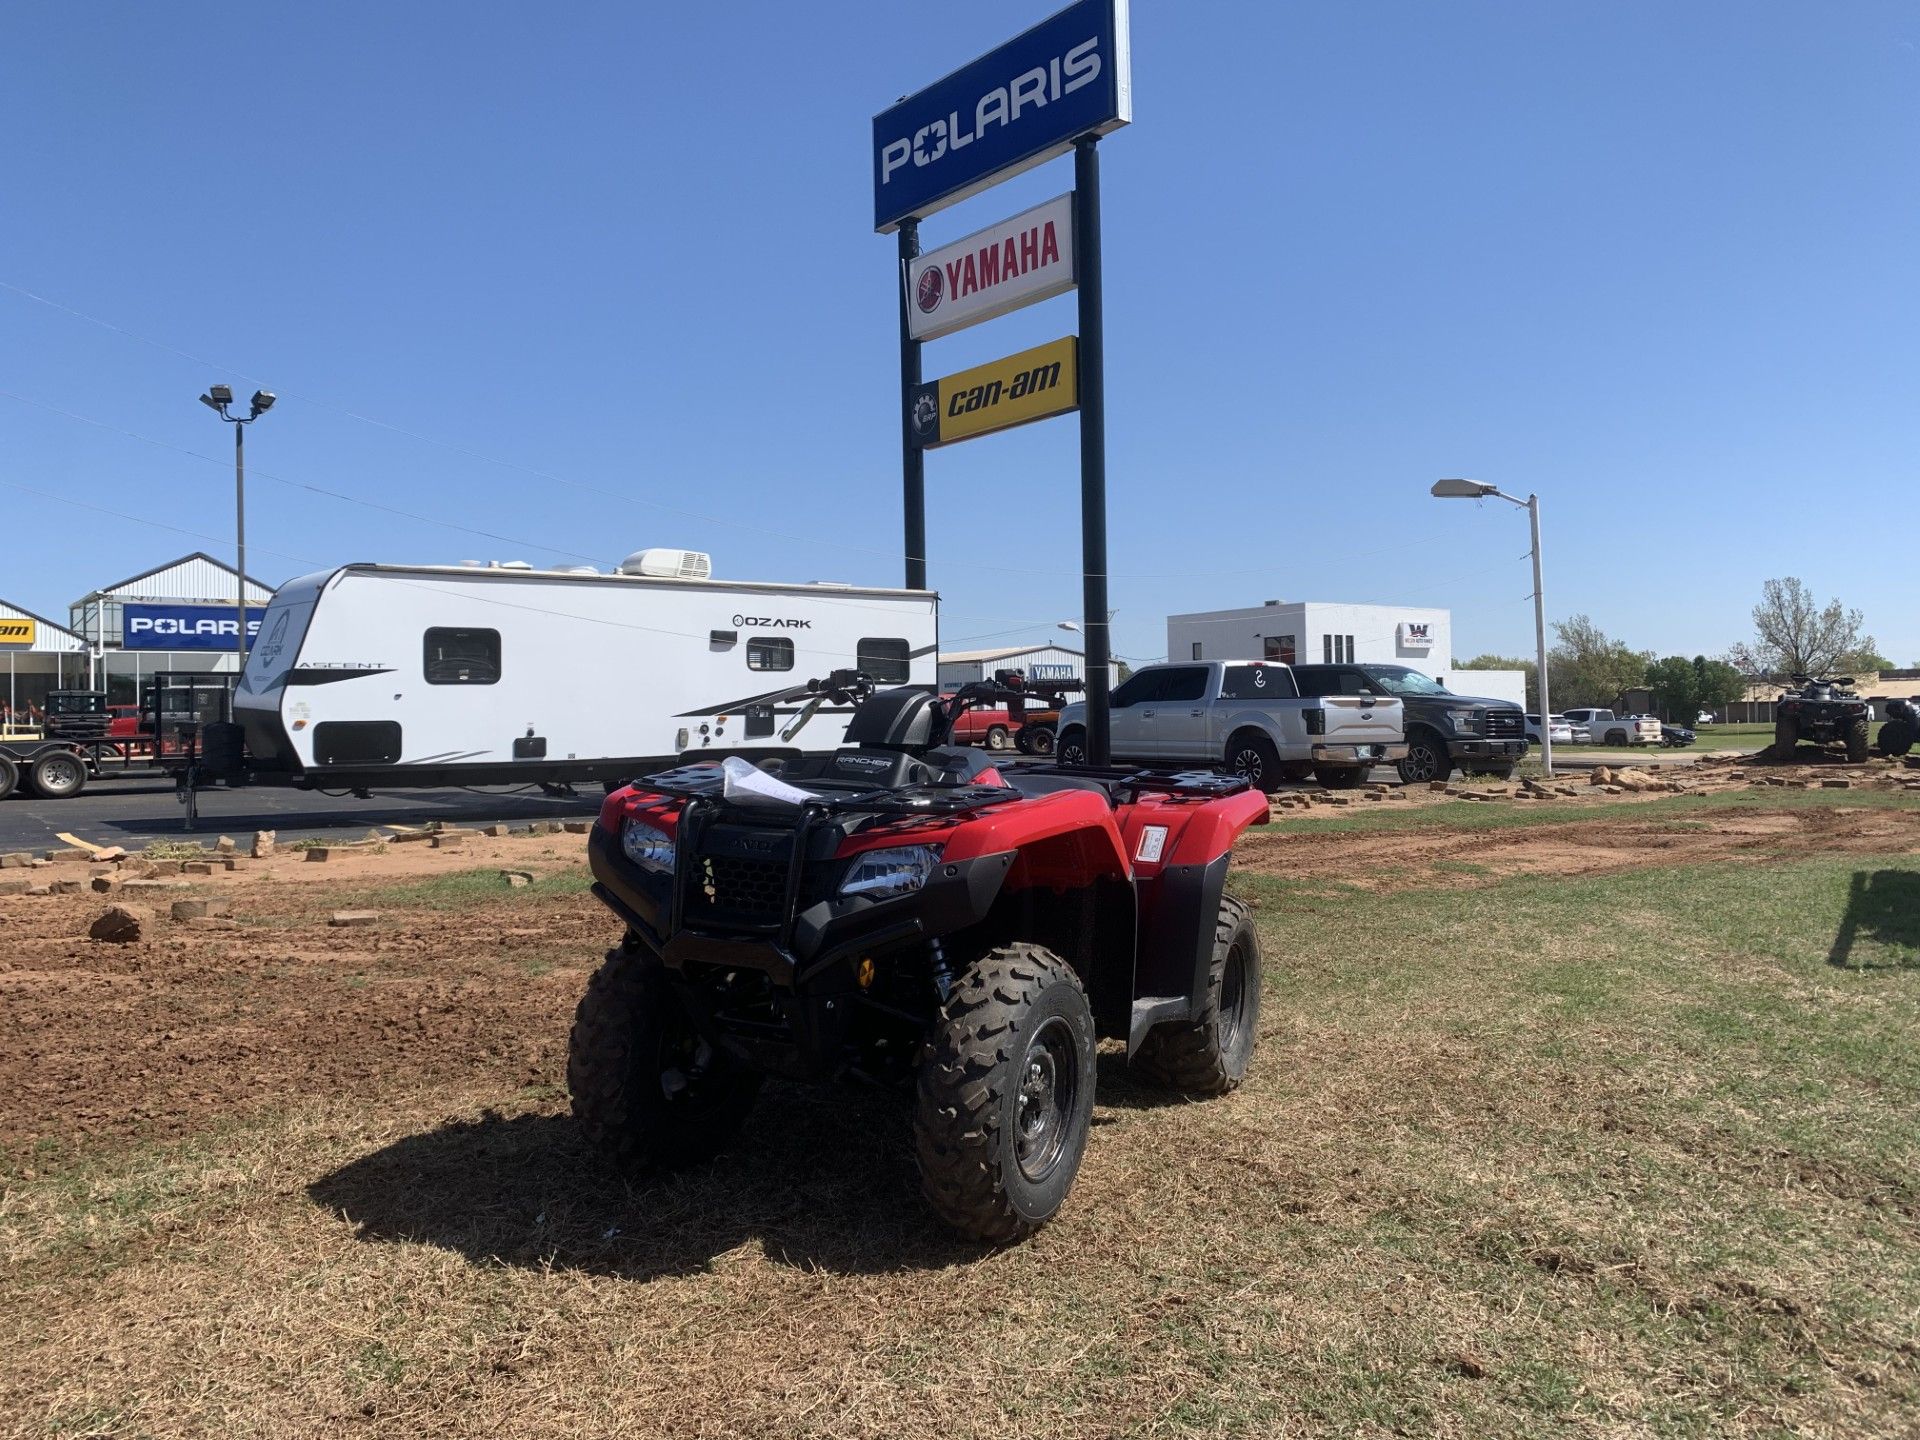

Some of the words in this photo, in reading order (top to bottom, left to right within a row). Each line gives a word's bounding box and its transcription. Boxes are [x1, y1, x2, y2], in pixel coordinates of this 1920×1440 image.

[882, 35, 1102, 185] POLARIS
[946, 220, 1060, 302] YAMAHA
[948, 361, 1062, 418] can-am
[130, 617, 262, 637] POLARS
[744, 616, 812, 629] OZARK
[1035, 666, 1073, 679] YAMAHA
[835, 757, 893, 767] RANCHER
